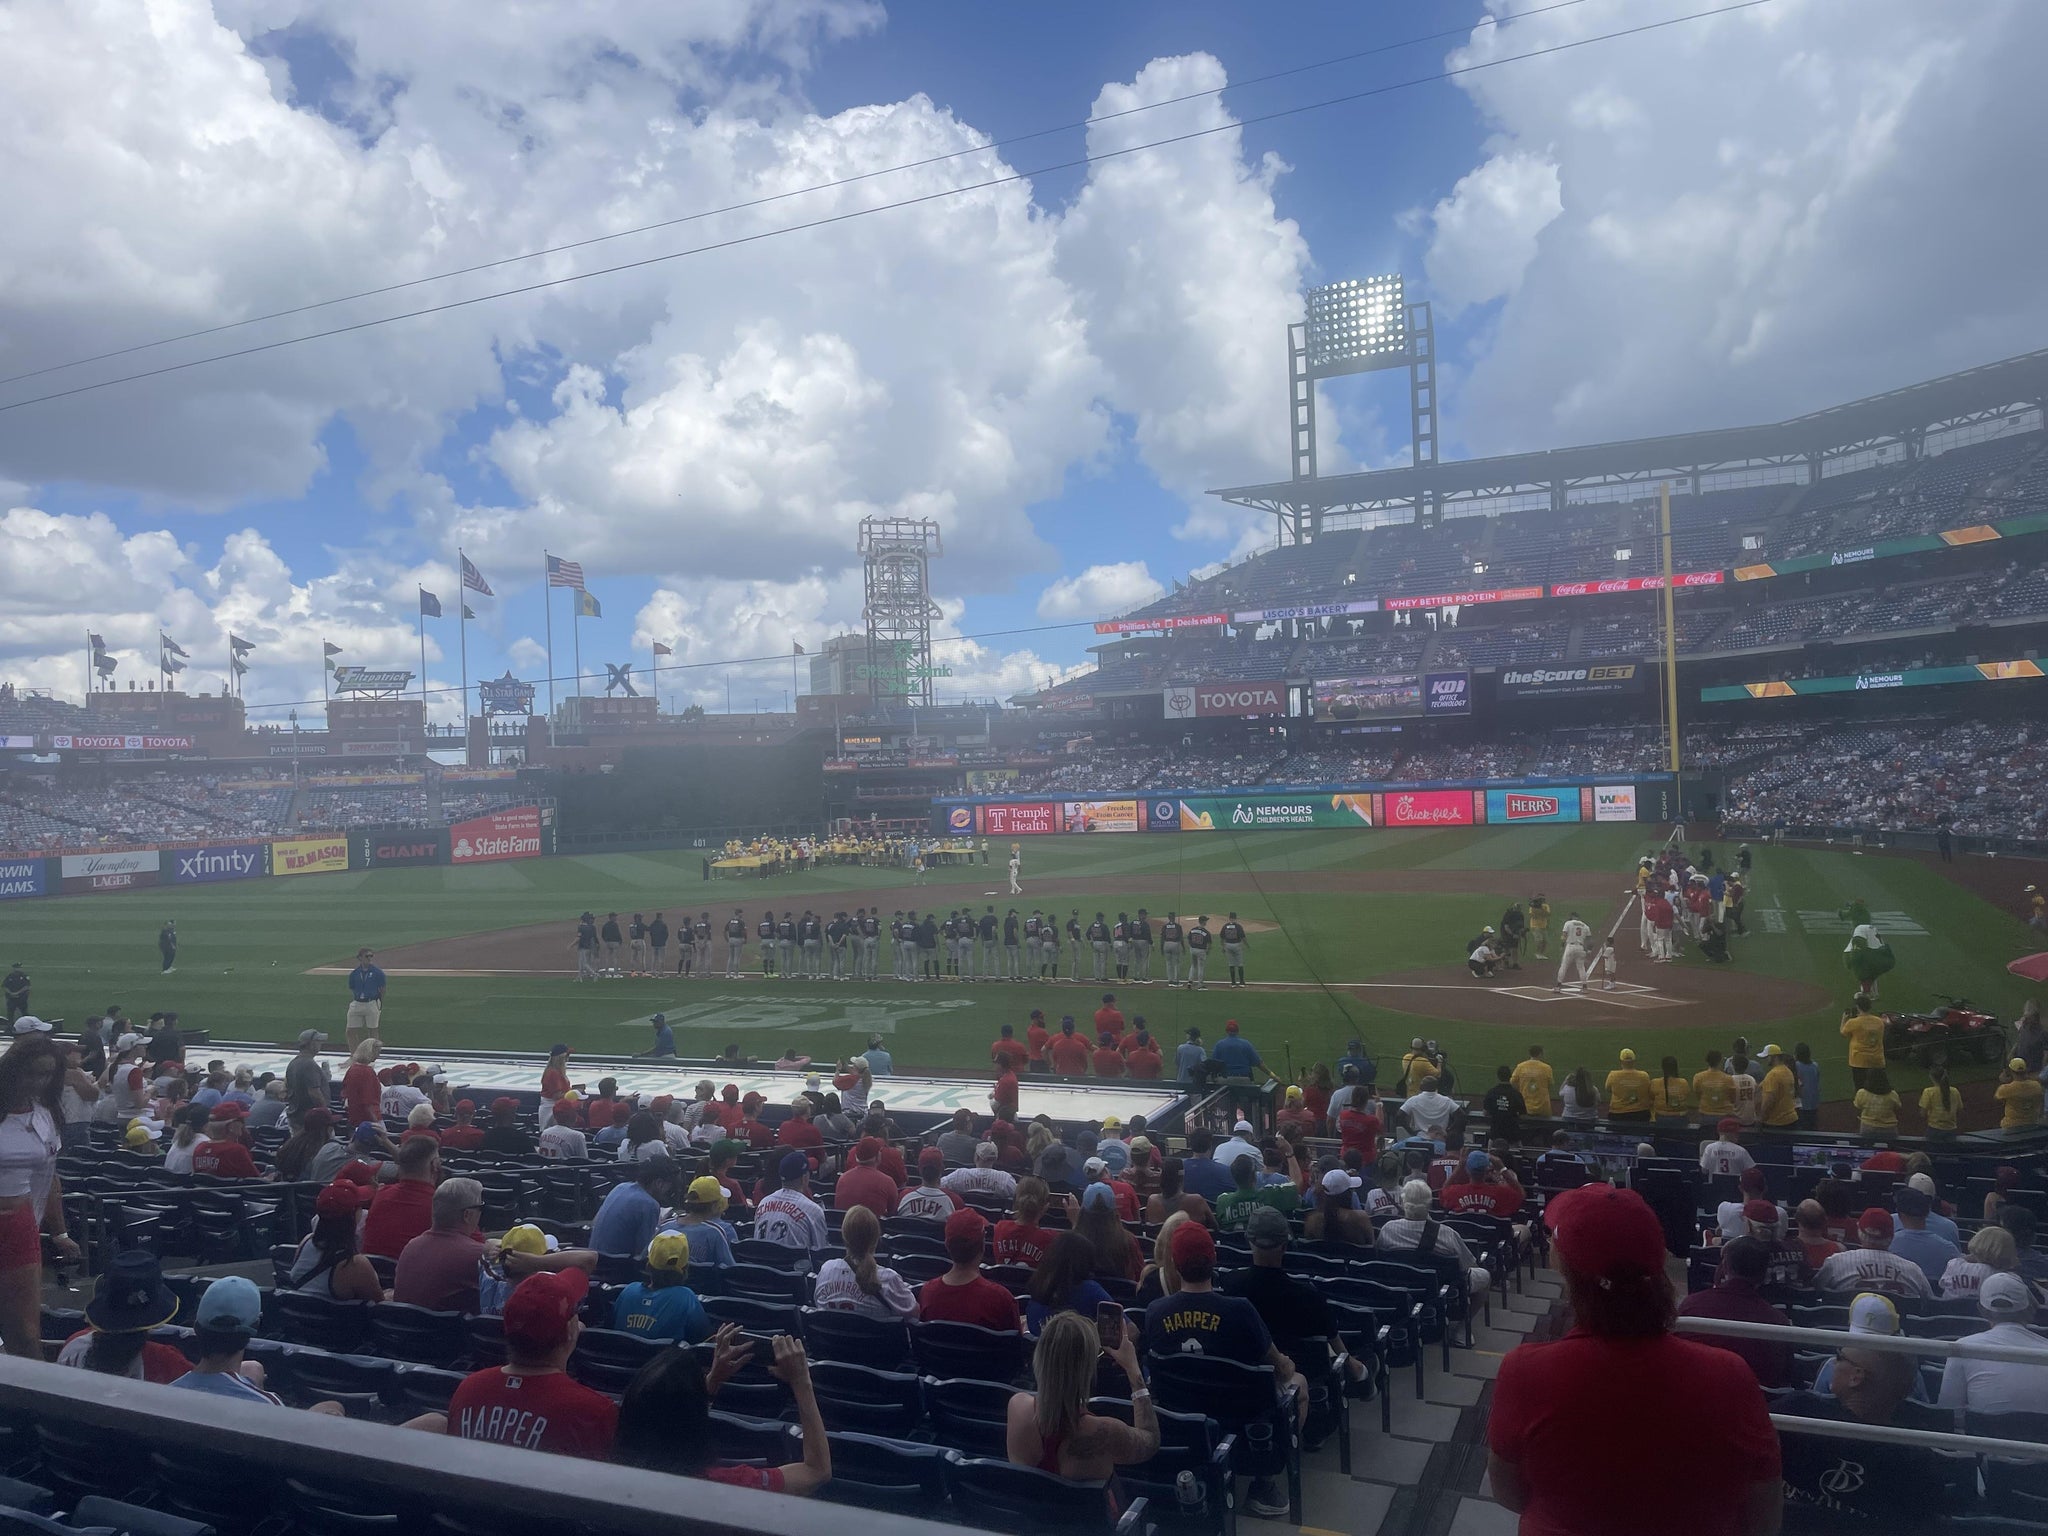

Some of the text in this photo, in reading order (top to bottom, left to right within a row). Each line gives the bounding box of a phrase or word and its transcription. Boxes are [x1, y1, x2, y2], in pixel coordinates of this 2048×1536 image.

[1844, 548, 1874, 560] NEMOURS
[1598, 580, 1628, 592] Coca-Cola
[1685, 572, 1717, 586] Coca-Cola
[1556, 584, 1587, 597] Coca-Cola
[1390, 599, 1418, 609] WHEY
[1420, 595, 1454, 606] BETTER
[1456, 592, 1496, 603] PROTEIN
[1307, 604, 1348, 615] BAKERY
[1118, 621, 1145, 631] Phillies
[1177, 615, 1222, 627] Deals roll in
[341, 667, 407, 684] Fitzpatrick
[916, 664, 953, 678] Bank
[1504, 667, 1632, 685] theScore BET
[1869, 674, 1903, 684] NEMOURS
[480, 688, 495, 698] ALL
[514, 687, 535, 698] GAME
[1432, 680, 1465, 695] KDI
[1201, 690, 1279, 709] TOYOTA
[1431, 699, 1467, 708] TECHNOLOGY
[76, 737, 121, 747] TOYOTA
[147, 738, 189, 748] TOYOTA
[179, 754, 207, 762] Fanatics
[989, 772, 1007, 780] PLAY
[1511, 799, 1552, 813] HERR'S
[1600, 794, 1631, 804] WM
[1011, 807, 1050, 821] Temple
[1097, 811, 1134, 819] From Cancer
[1256, 805, 1313, 816] NEMOURS
[1395, 796, 1463, 823] Chick-fil-A
[1011, 819, 1048, 832] Health
[1256, 815, 1290, 824] CHILDREN'S
[376, 844, 437, 858] GIANT
[81, 850, 139, 873] Yuengling
[180, 849, 255, 878] xfinity
[92, 875, 132, 888] LAGER
[384, 1101, 400, 1116] 34
[734, 1127, 751, 1138] NOLA
[1719, 1158, 1730, 1173] 3
[964, 1177, 998, 1192] HAMELS
[910, 1199, 942, 1216] UTLEY
[1458, 1193, 1497, 1209] ROLLINS
[755, 1200, 807, 1223] SCHWARBER
[1856, 1262, 1901, 1283] UTLEY
[626, 1313, 658, 1332] STOTT
[1161, 1310, 1221, 1334] HARPER
[461, 1405, 548, 1451] HARPER
